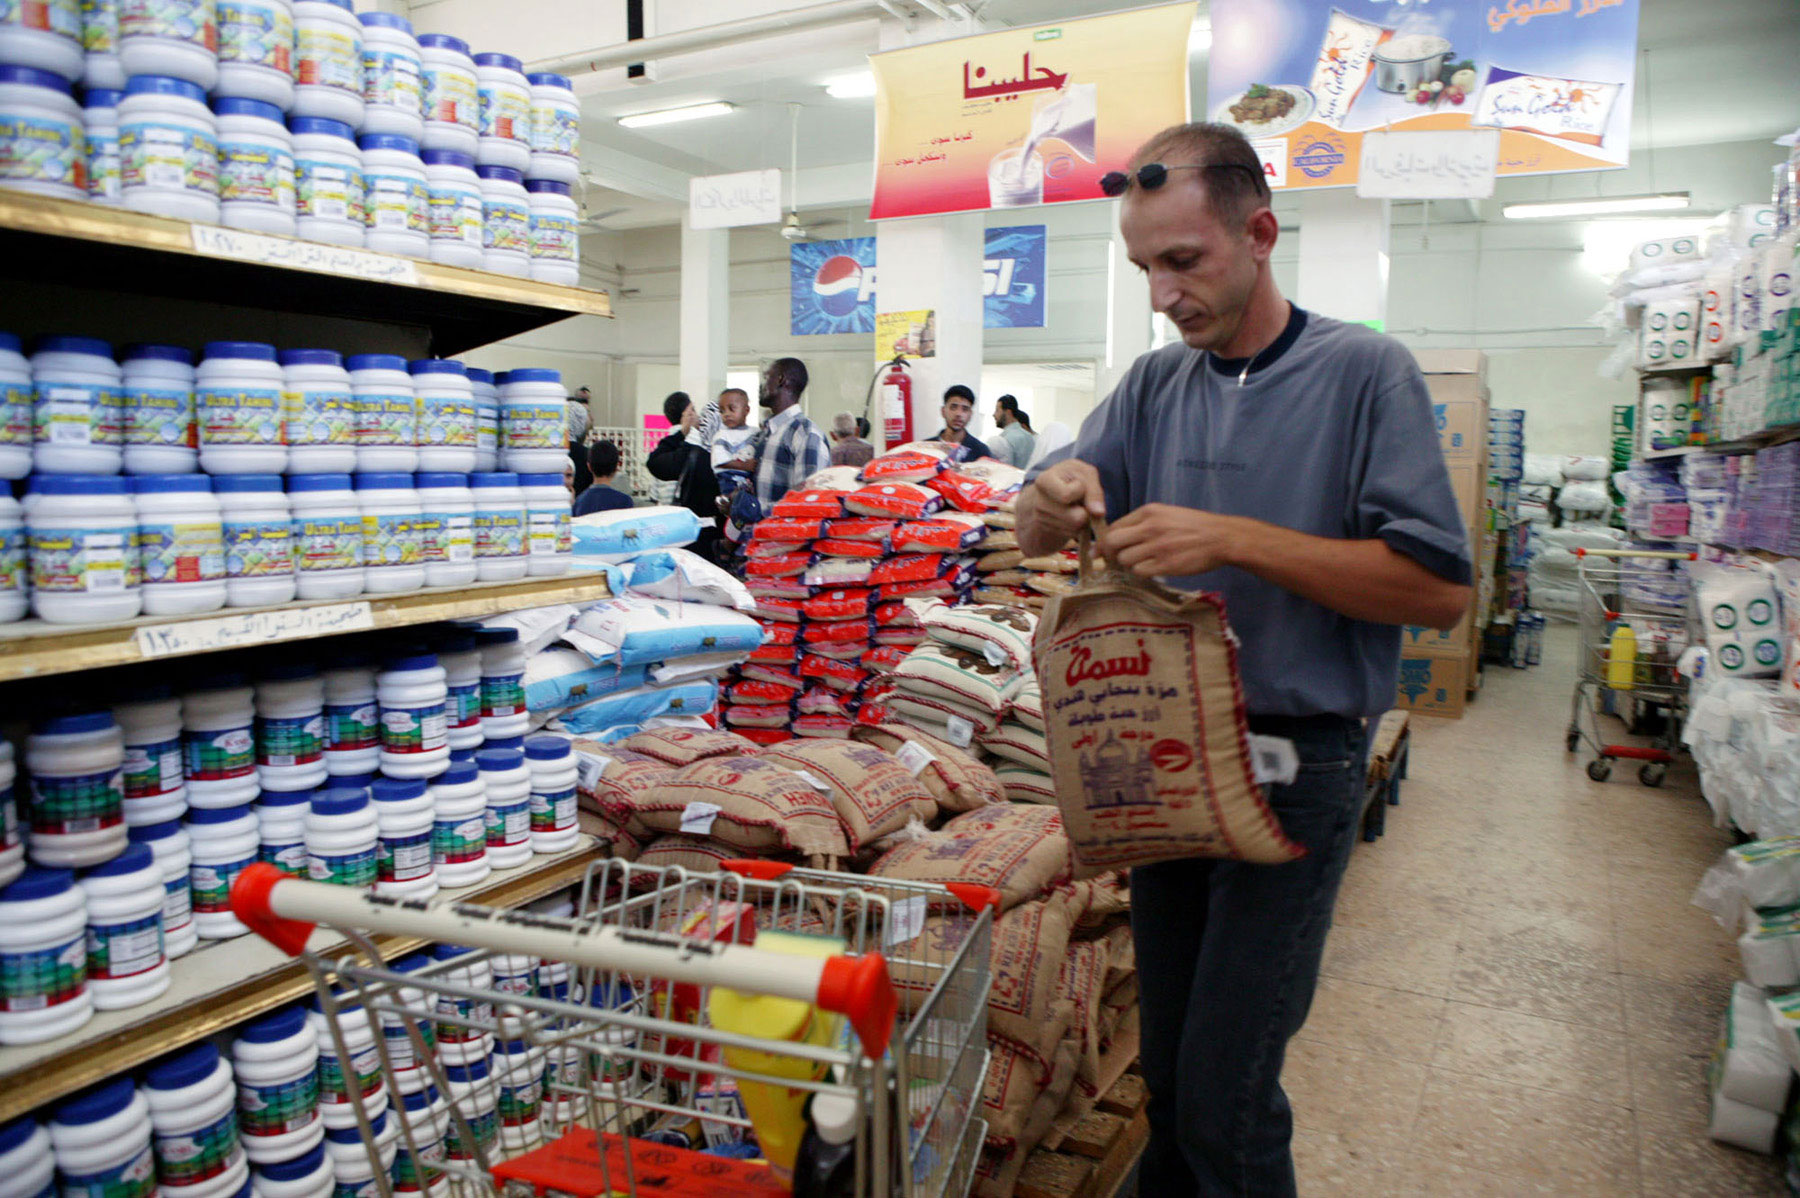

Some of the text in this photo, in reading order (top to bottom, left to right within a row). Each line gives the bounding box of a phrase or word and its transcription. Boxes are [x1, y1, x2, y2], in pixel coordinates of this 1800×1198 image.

[1491, 94, 1523, 115] Sun
[1527, 92, 1573, 115] Gold
[1065, 638, 1153, 687] نسمة
